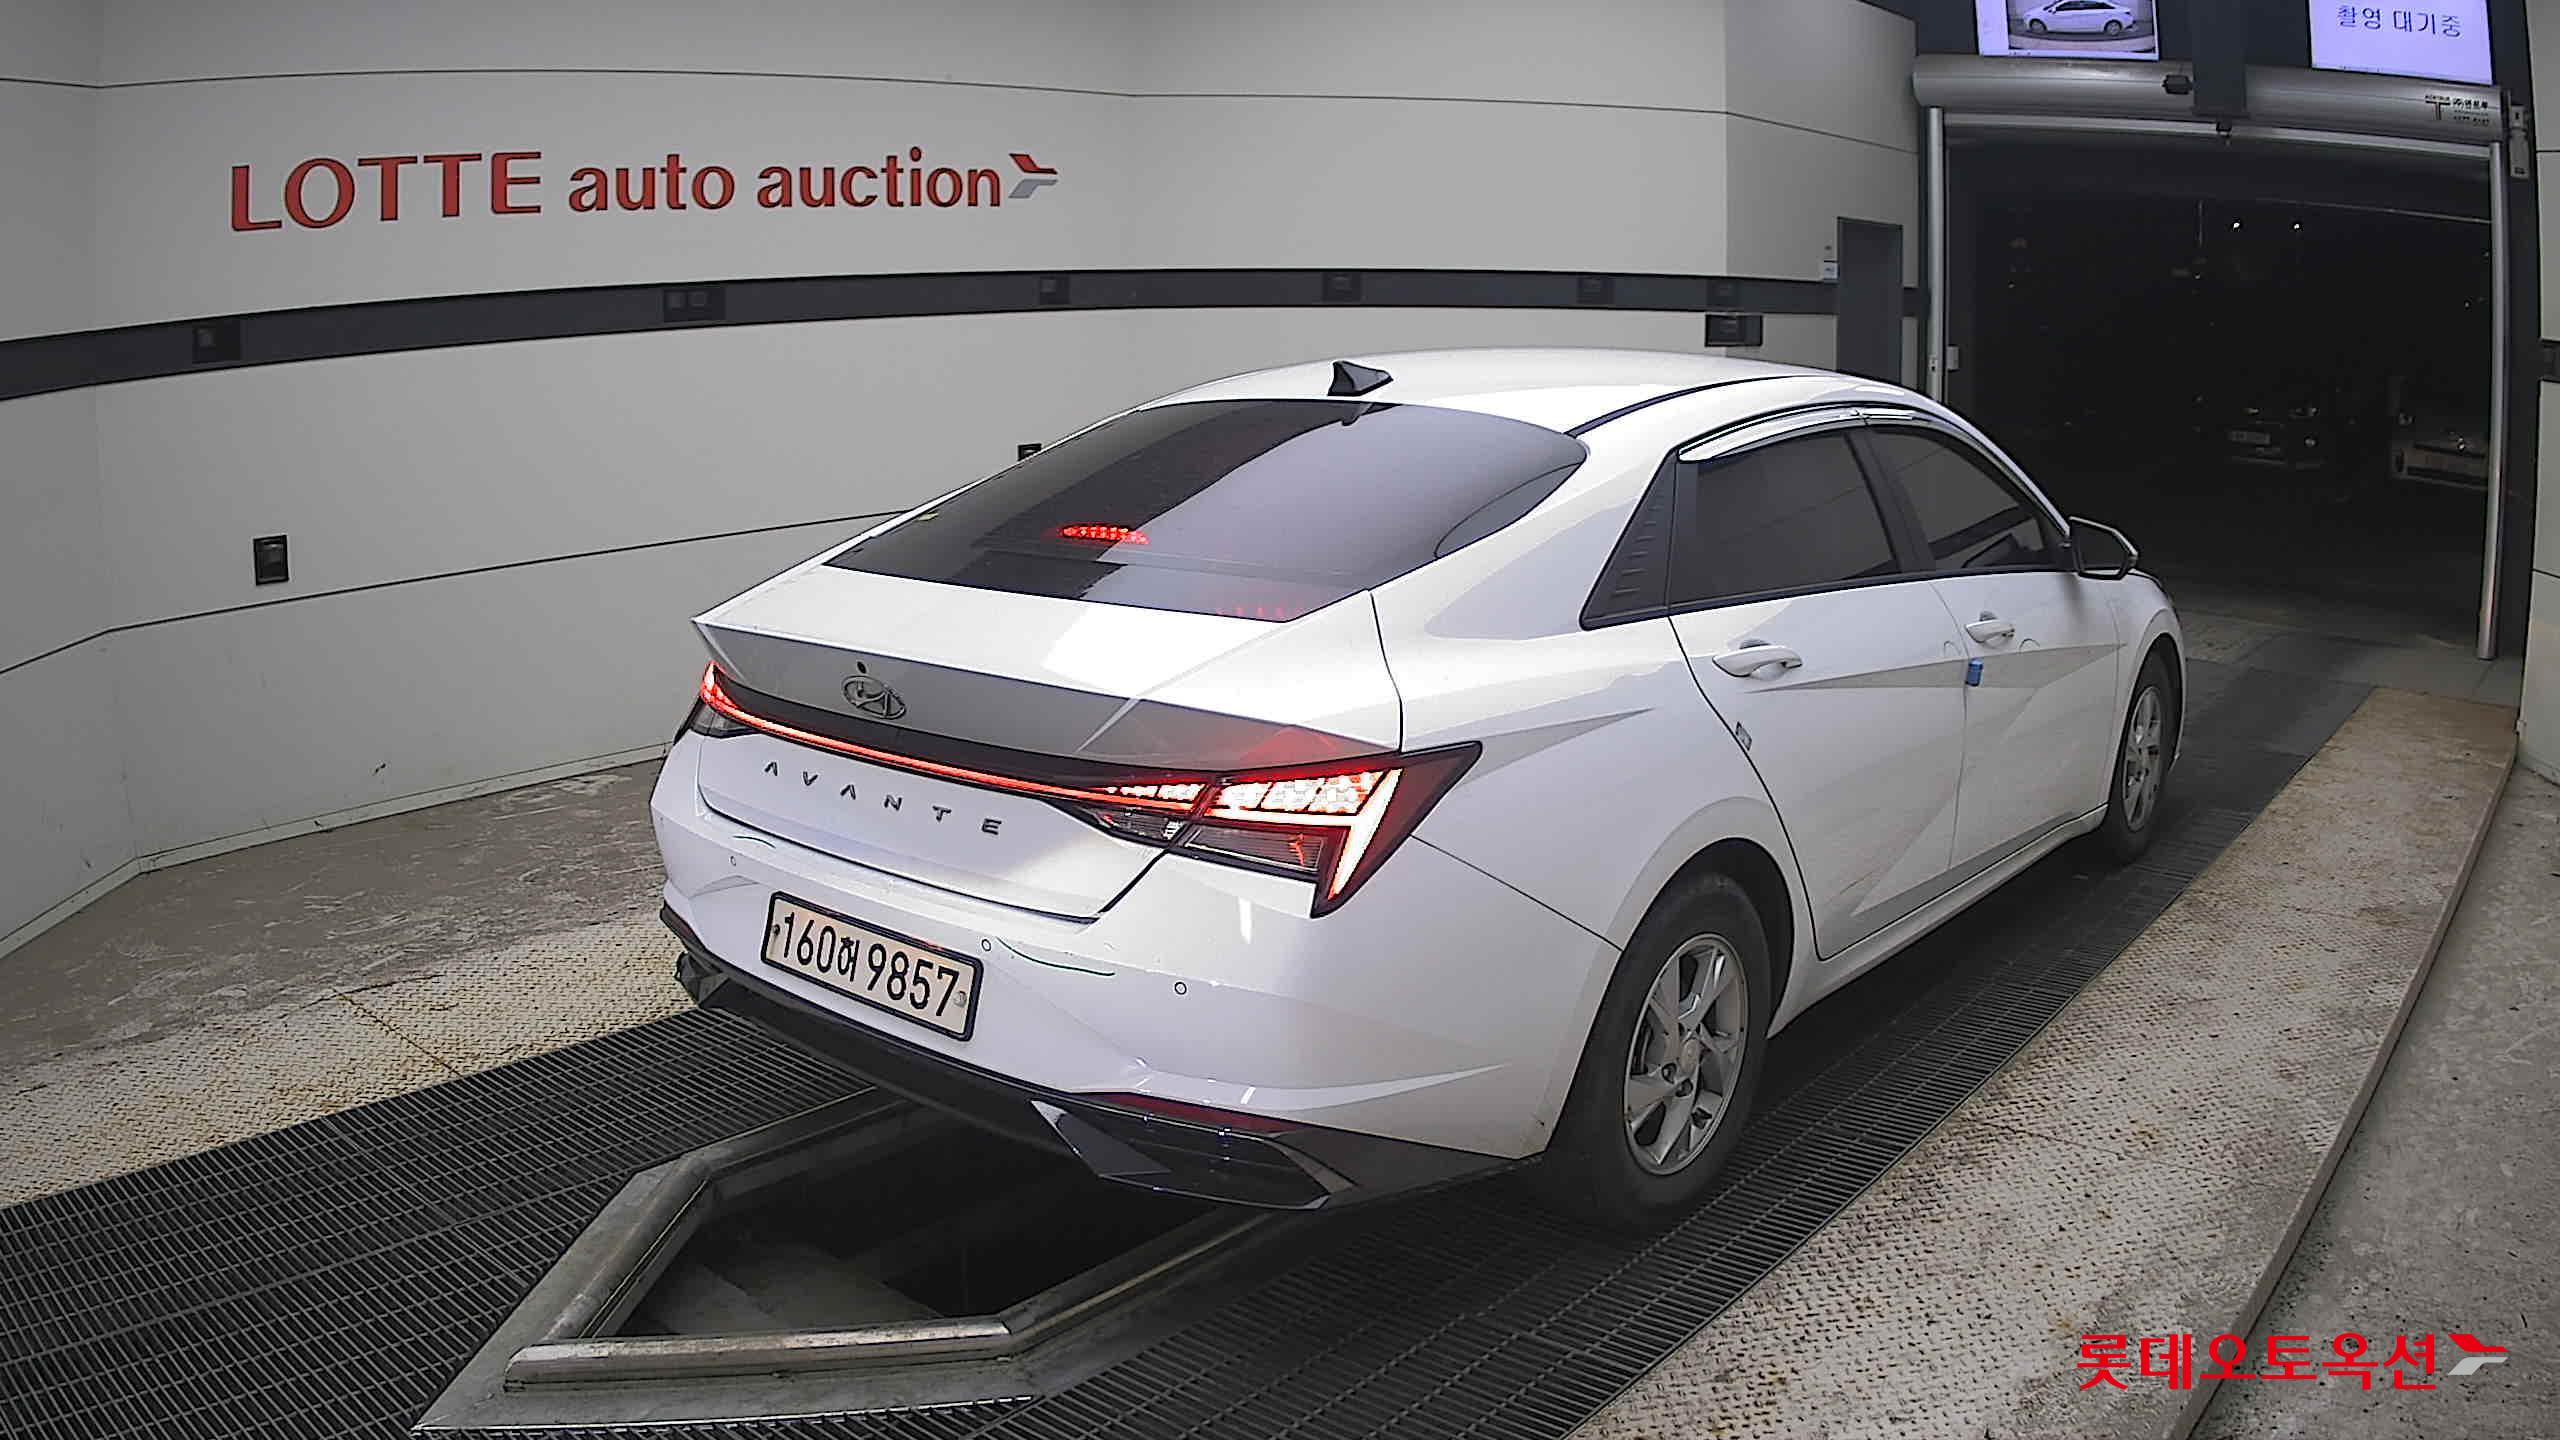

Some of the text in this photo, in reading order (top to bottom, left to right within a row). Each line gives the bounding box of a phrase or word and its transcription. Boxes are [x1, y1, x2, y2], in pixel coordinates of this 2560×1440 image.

[2337, 5, 2461, 37] 촬영 대기중
[231, 147, 1001, 232] LOTTE auto auction
[764, 761, 1002, 836] AVANTE
[783, 912, 960, 1017] 160허 9857
